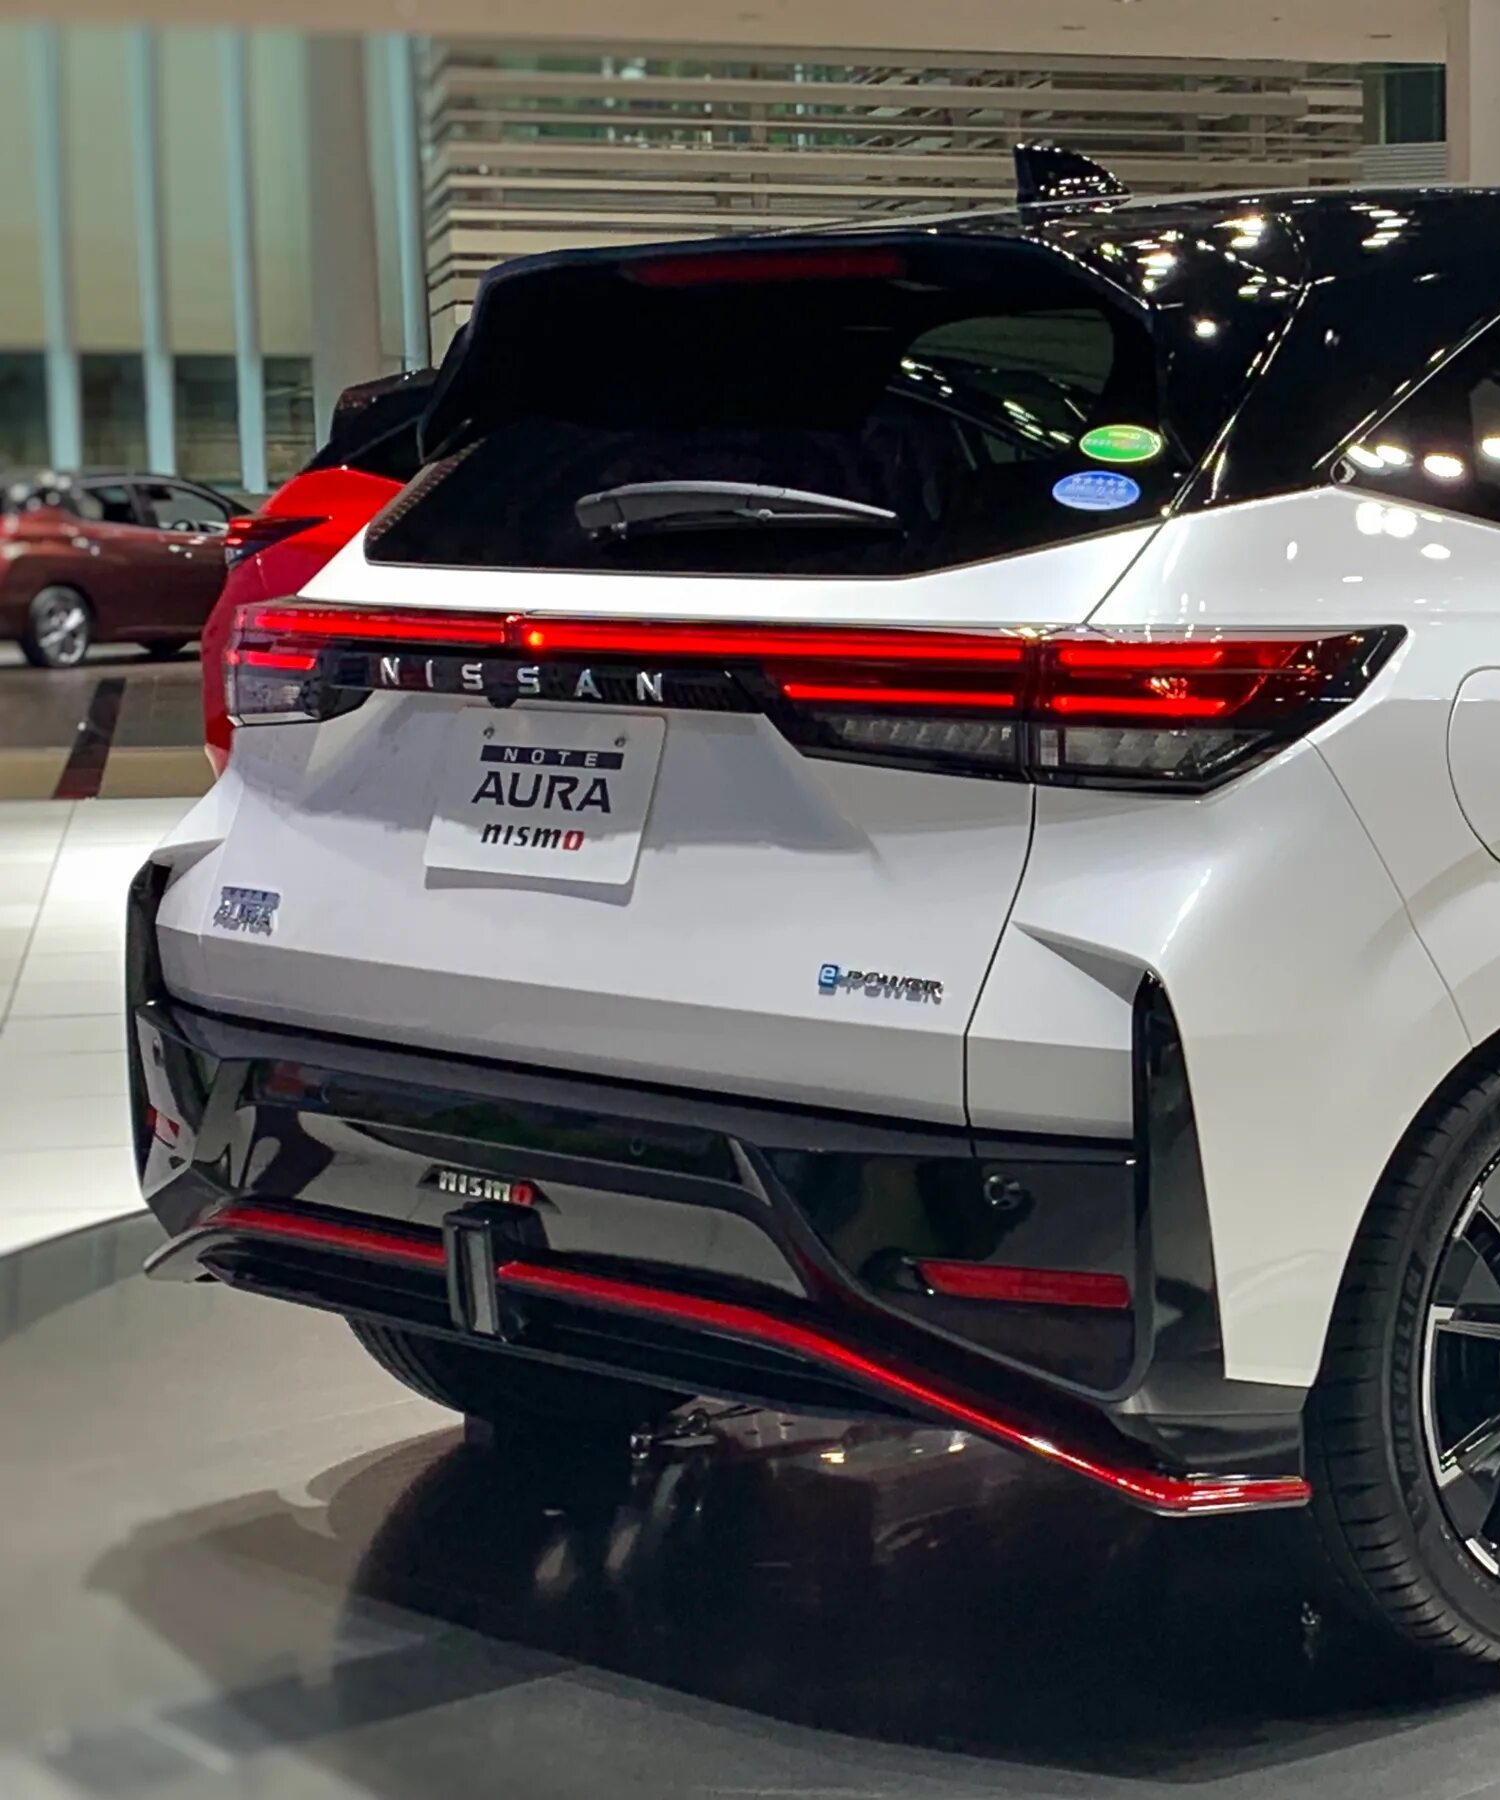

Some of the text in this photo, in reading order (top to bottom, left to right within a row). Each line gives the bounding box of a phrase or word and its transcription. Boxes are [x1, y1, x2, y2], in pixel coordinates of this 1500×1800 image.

[379, 656, 664, 702] NISSAN
[503, 747, 599, 768] NOTE
[471, 771, 611, 814] AURA
